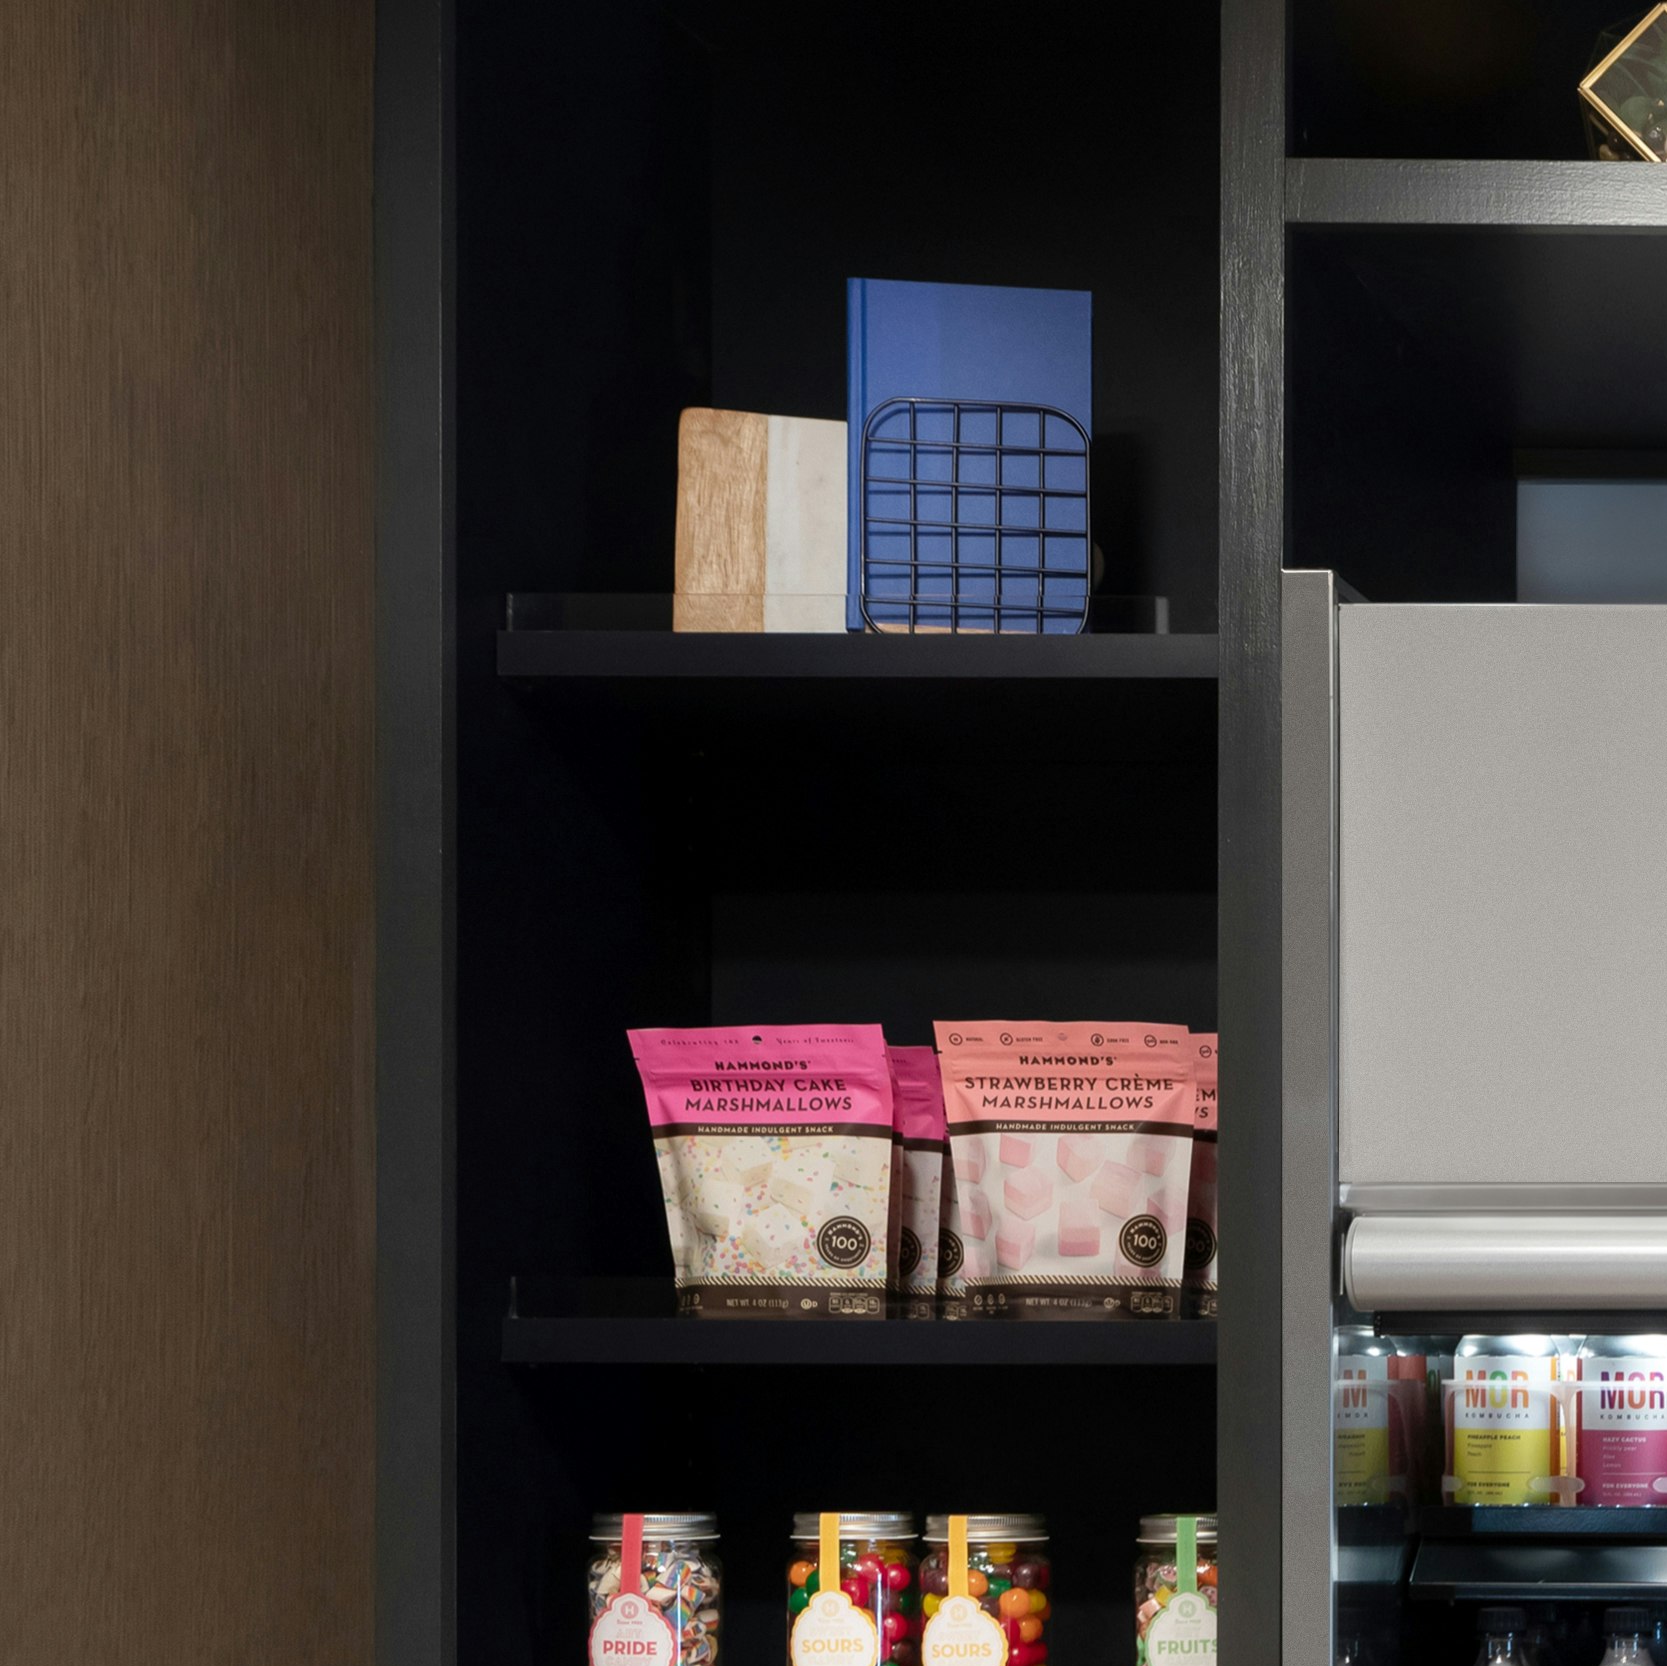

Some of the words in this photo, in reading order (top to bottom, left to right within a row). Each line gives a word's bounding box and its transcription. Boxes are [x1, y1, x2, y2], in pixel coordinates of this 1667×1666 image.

[715, 1060, 811, 1072] HAMMOND'S
[1019, 1056, 1115, 1067] HAMMOND'S
[690, 1079, 787, 1093] BIRTHDAY
[794, 1078, 848, 1092] CAKE
[965, 1076, 1098, 1092] STRAWBERRY
[1105, 1073, 1175, 1091] CRÈME
[685, 1096, 853, 1112] MARSHMALLOWS
[982, 1095, 1155, 1111] MARSHMALLOWS
[698, 1125, 748, 1134] HANDMADE
[752, 1126, 803, 1135] INDULGENT
[805, 1126, 835, 1134] SNACK
[995, 1123, 1047, 1132] HANDMADE
[1050, 1123, 1103, 1132] INDULGENT
[1105, 1124, 1136, 1132] SNACK
[830, 1235, 858, 1251] 100
[1132, 1234, 1157, 1250] 100
[1465, 1412, 1531, 1420] KOMBUCHA
[602, 1640, 658, 1656] PRIDE
[801, 1638, 864, 1654] SOURS
[930, 1642, 993, 1659] SOURS
